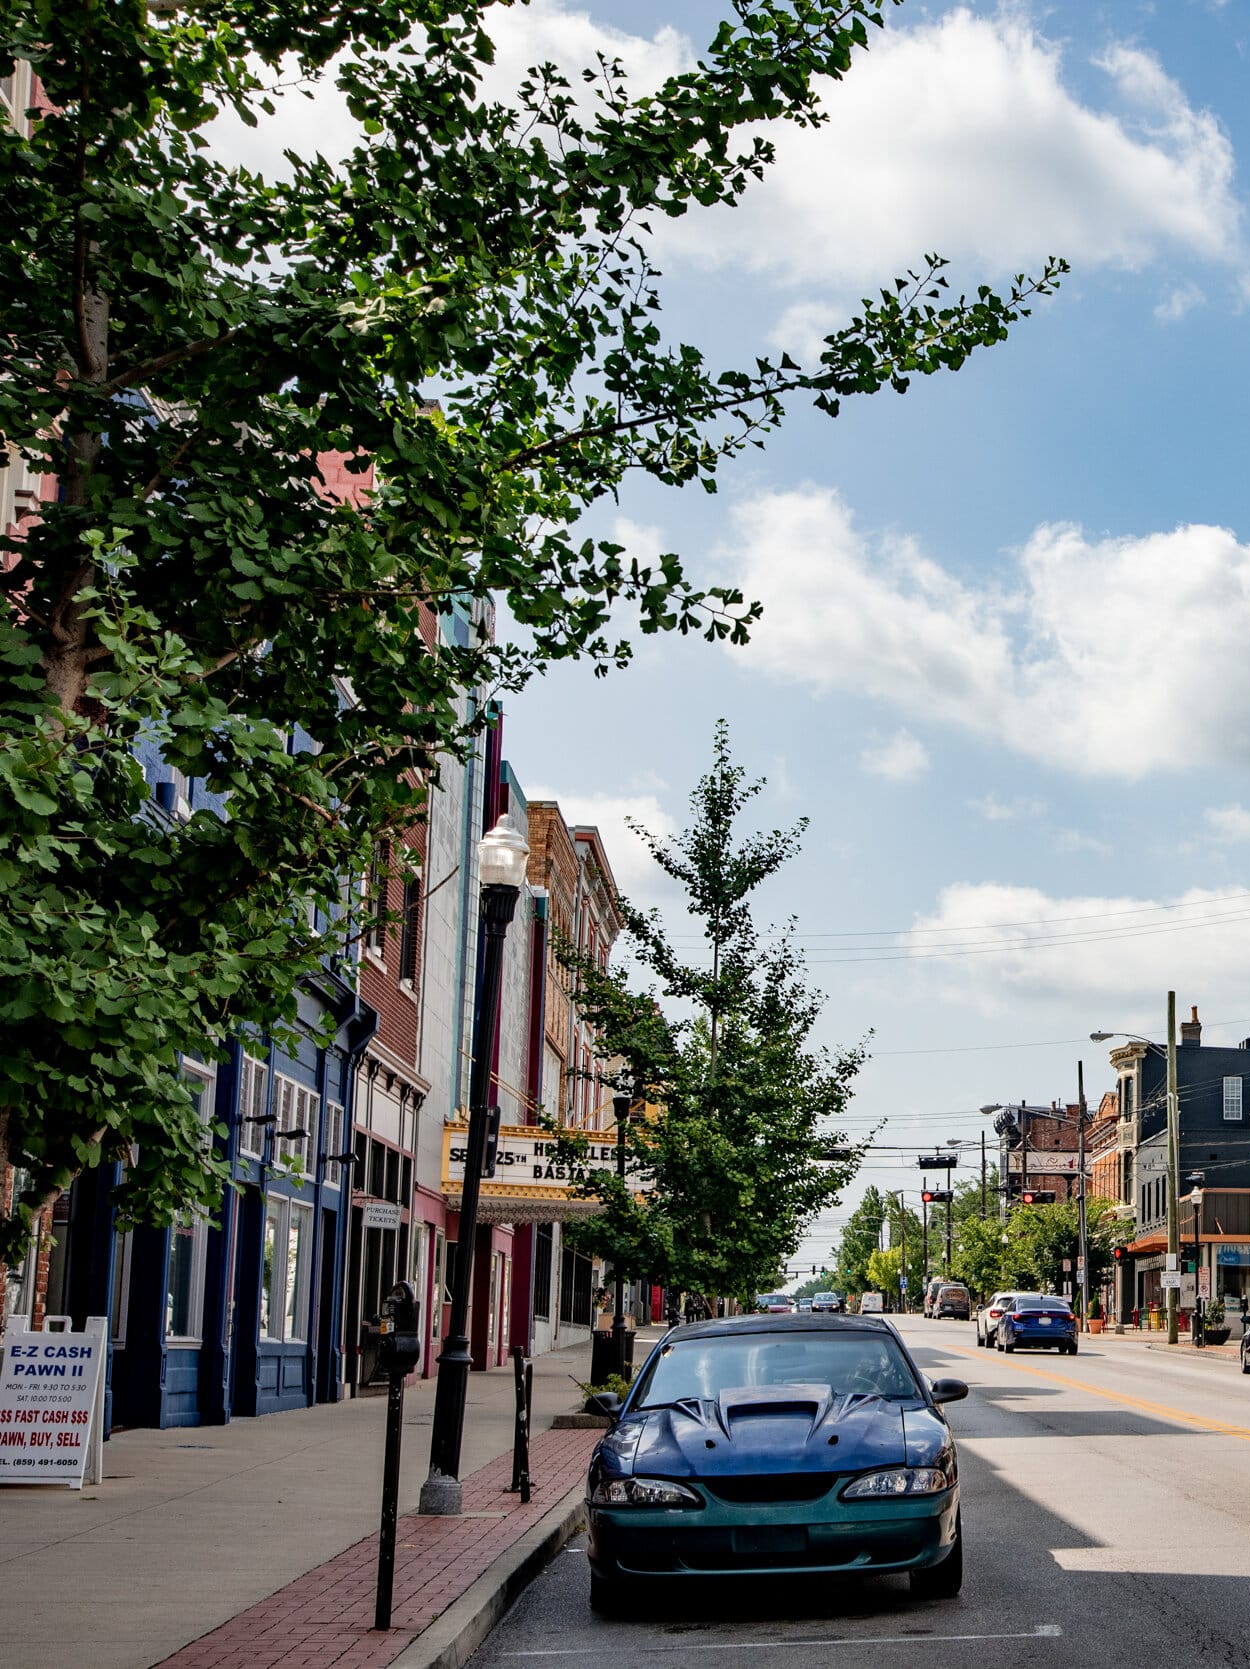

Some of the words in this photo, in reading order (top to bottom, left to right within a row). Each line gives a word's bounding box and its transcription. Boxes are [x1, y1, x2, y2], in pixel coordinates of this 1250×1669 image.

[366, 1207, 400, 1215] PURCHASE
[369, 1216, 397, 1224] TICKETS
[11, 1346, 39, 1357] E-Z
[44, 1346, 92, 1358] CASH
[14, 1364, 66, 1376] PAWN
[71, 1365, 84, 1377] II
[14, 1410, 40, 1423] FAST
[42, 1410, 69, 1424] CASH
[30, 1432, 53, 1449] BUY,
[56, 1432, 81, 1447] SELL
[13, 1458, 36, 1466] (859)
